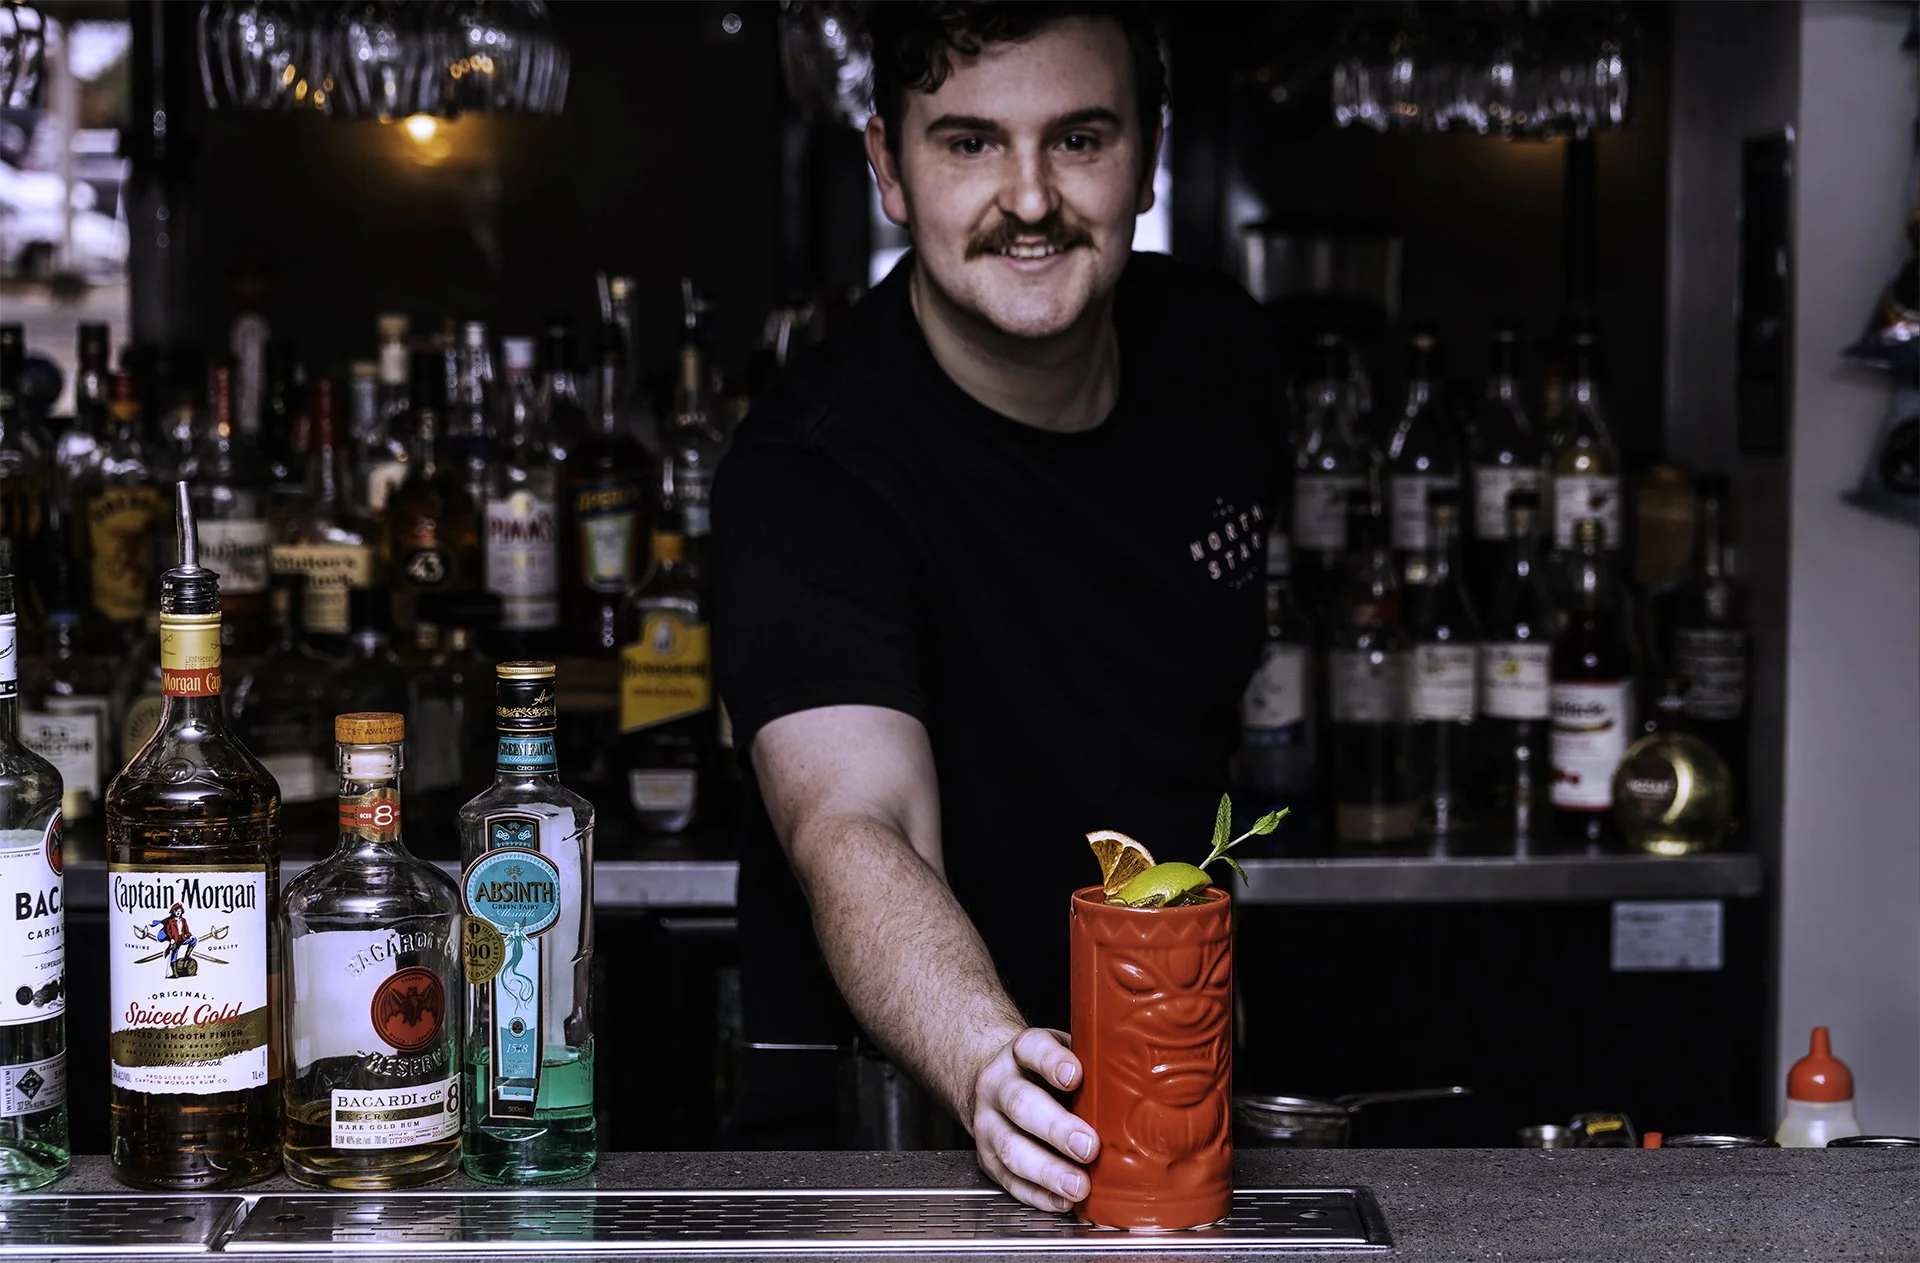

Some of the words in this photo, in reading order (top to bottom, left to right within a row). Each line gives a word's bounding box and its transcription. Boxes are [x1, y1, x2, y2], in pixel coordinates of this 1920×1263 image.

[1189, 502, 1264, 562] NORTH
[1208, 531, 1262, 581] STAR
[163, 672, 201, 695] Morgan
[374, 804, 393, 826] 8
[114, 875, 174, 914] Captain
[176, 878, 256, 914] Morgan
[475, 880, 554, 903] ABSINTH
[28, 926, 60, 941] CARTA
[208, 944, 238, 952] QUALITY
[152, 991, 207, 1000] ORIGINAL
[125, 1001, 190, 1026] Spiced
[193, 1001, 243, 1029] Gold
[210, 1029, 243, 1040] FINISH
[337, 1093, 418, 1108] BACARDI
[445, 1082, 459, 1114] 8
[369, 1122, 396, 1131] GOLD
[401, 1120, 420, 1129] RUM
